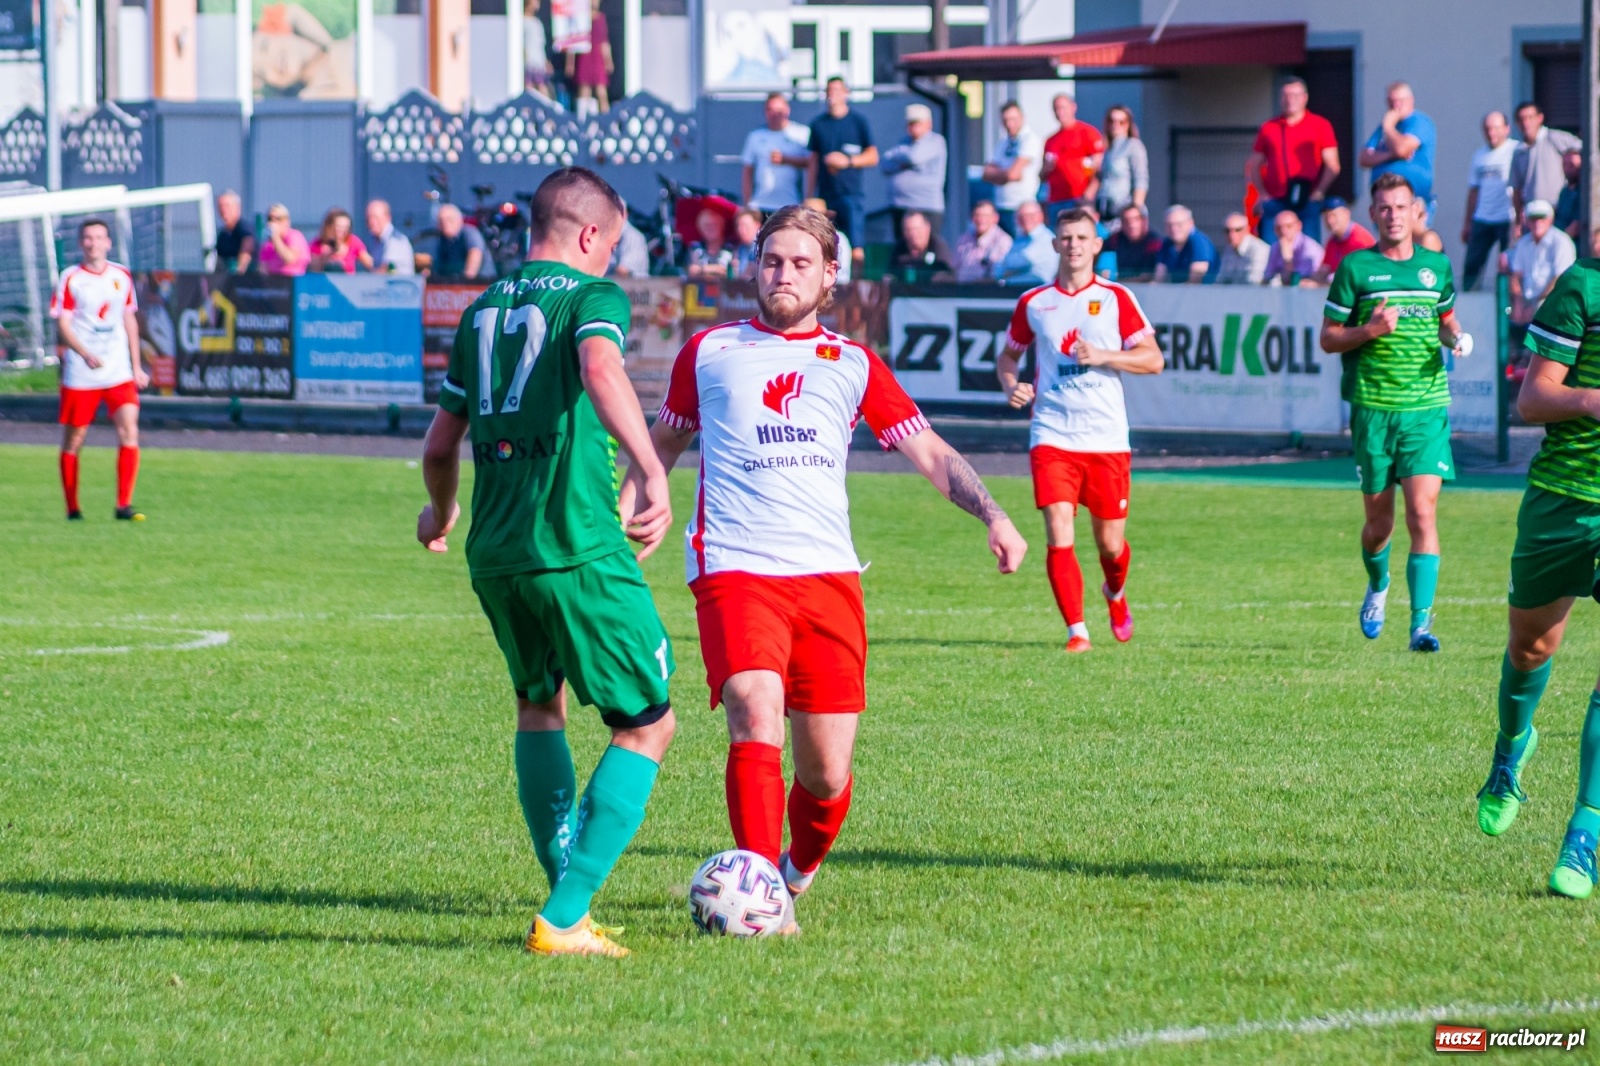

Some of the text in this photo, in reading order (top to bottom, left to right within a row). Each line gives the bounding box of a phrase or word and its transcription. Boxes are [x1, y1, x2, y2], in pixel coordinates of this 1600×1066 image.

[473, 303, 548, 416] 17
[1153, 314, 1321, 376] ERAKOLL
[473, 431, 563, 466] ROSAT
[756, 423, 817, 445] Husar
[743, 456, 799, 472] GALERIA
